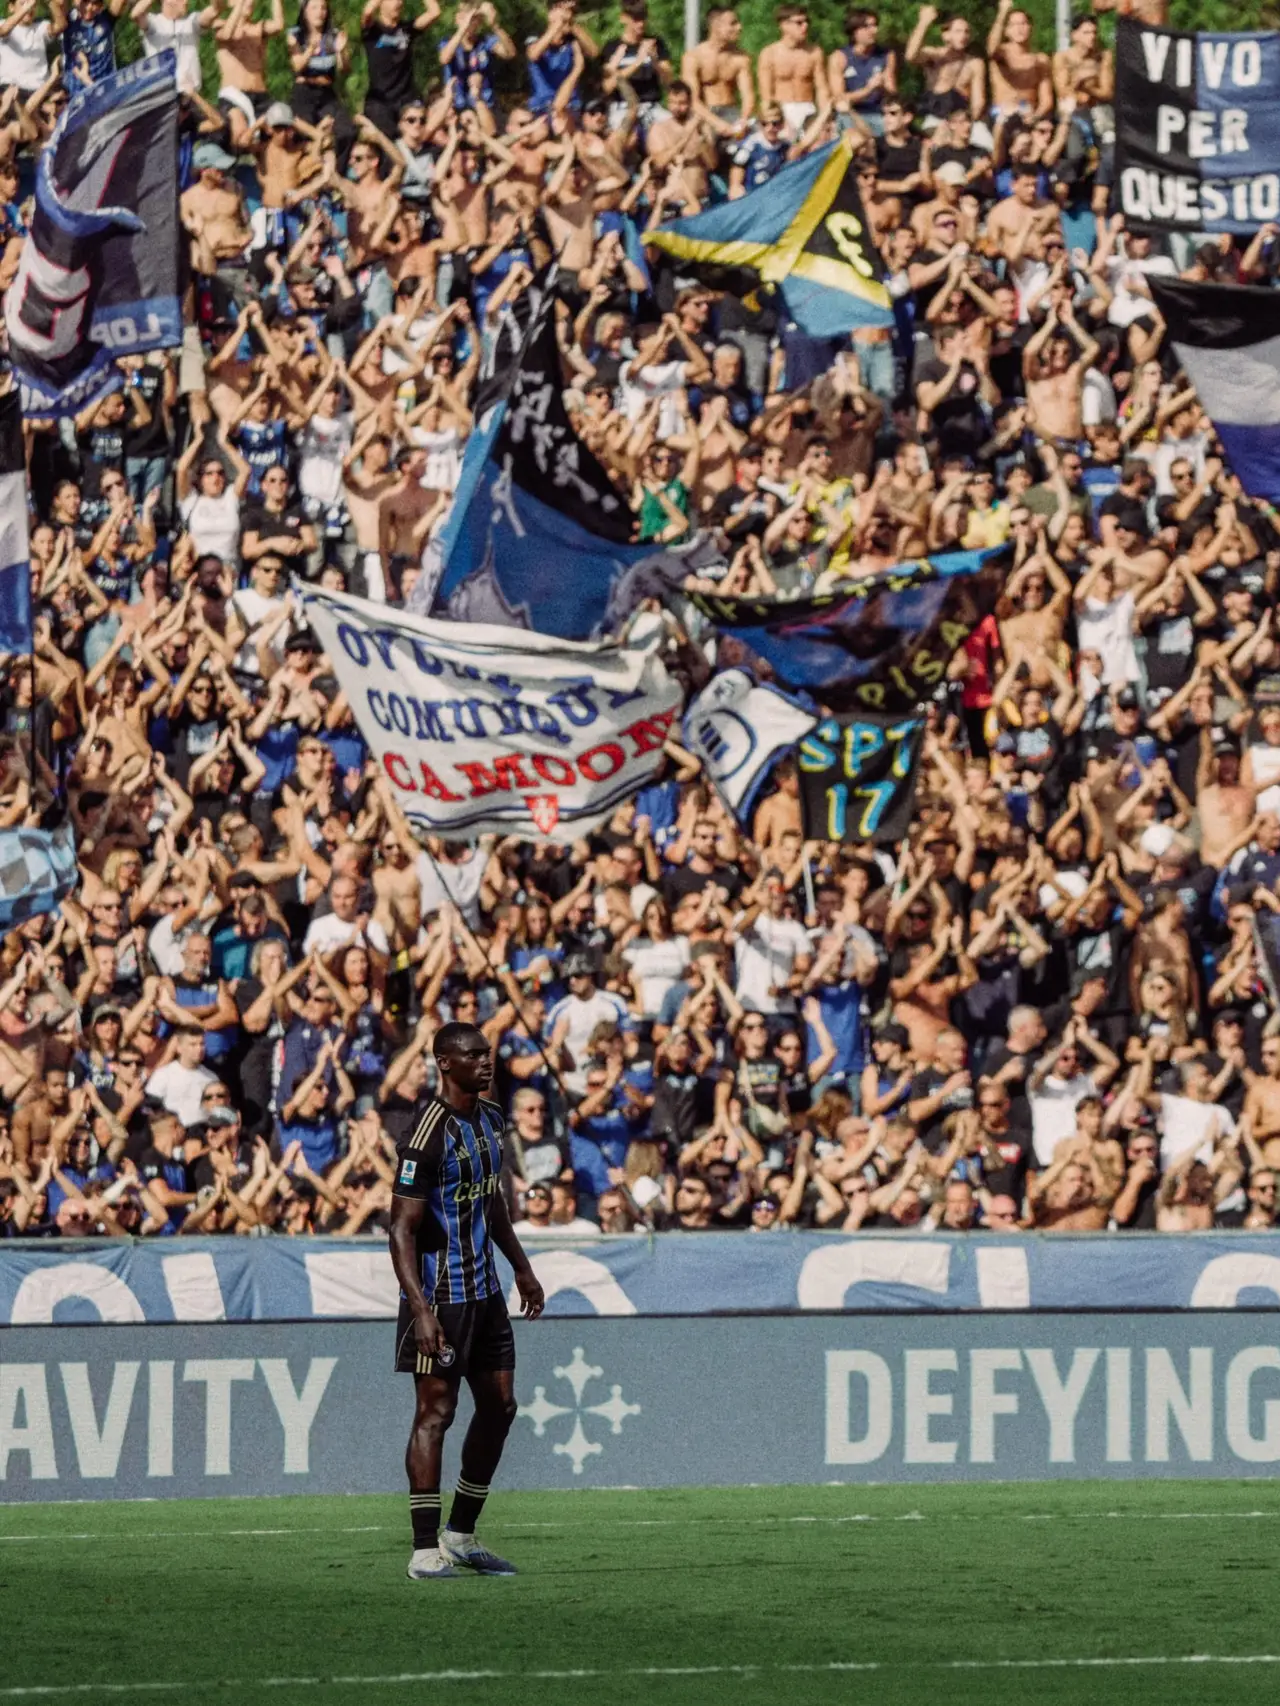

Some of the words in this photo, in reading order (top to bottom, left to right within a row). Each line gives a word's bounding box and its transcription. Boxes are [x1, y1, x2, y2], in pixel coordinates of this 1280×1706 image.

[1140, 32, 1262, 89] VIVO
[1156, 104, 1250, 158] PER
[1120, 167, 1280, 221] QUESTO
[826, 781, 897, 840] 17
